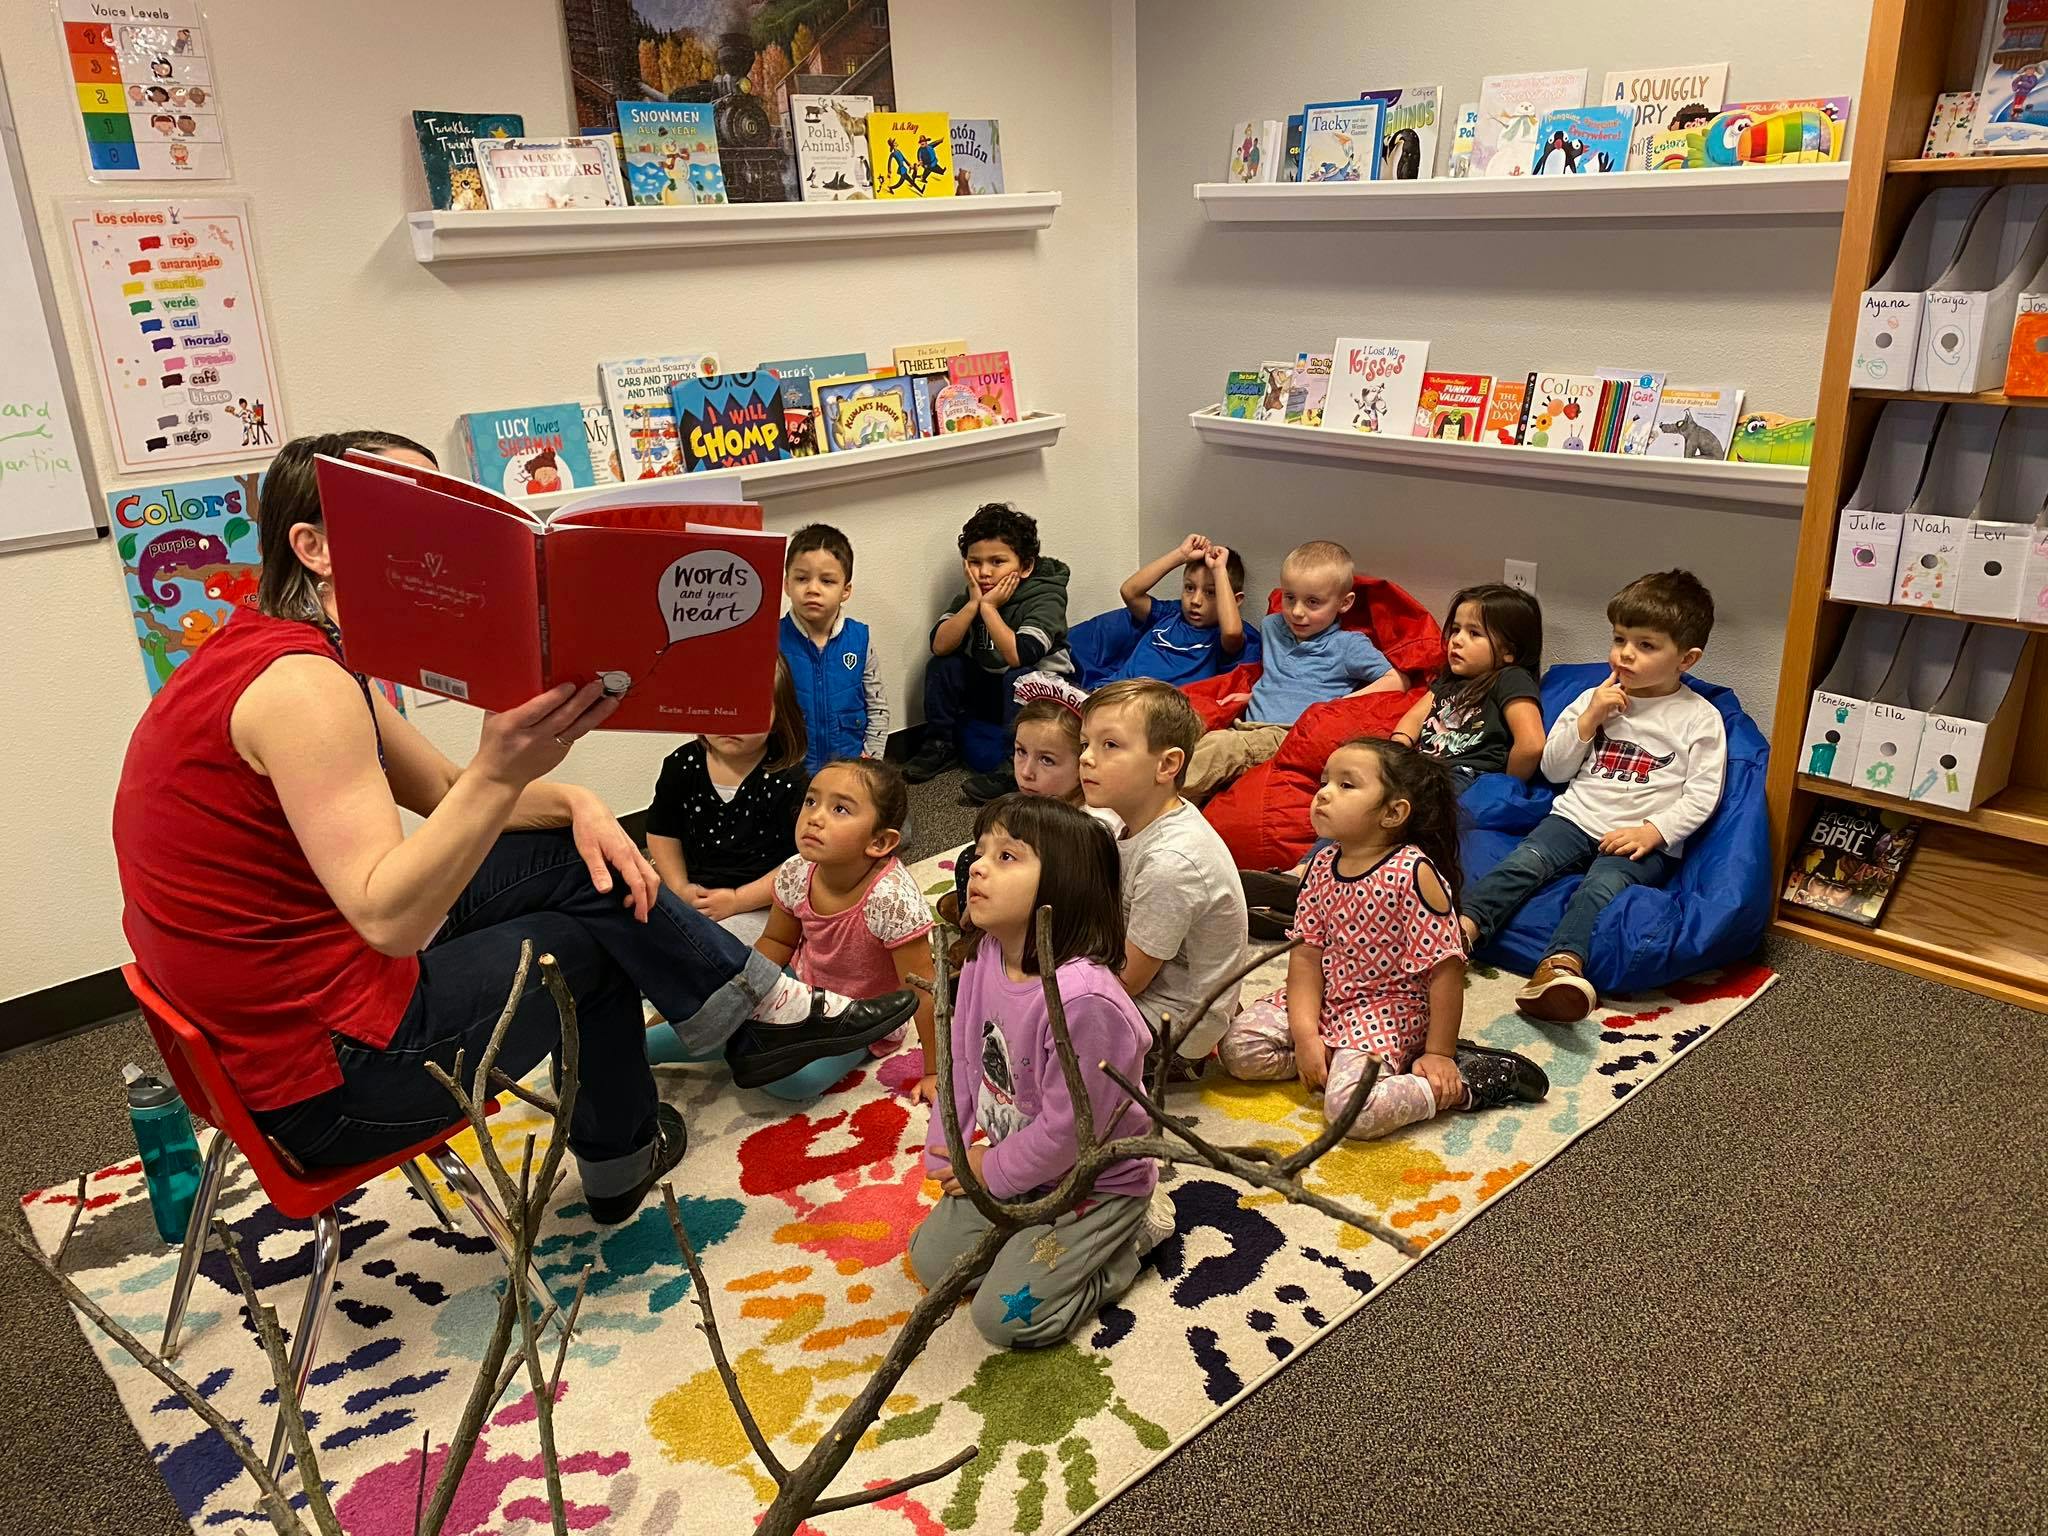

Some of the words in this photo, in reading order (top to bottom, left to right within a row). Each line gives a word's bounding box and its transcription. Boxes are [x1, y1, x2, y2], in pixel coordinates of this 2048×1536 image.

[91, 4, 126, 17] Voice
[131, 5, 169, 20] Levels
[91, 59, 102, 74] 3
[96, 90, 109, 105] 2
[1616, 81, 1625, 101] A
[1630, 76, 1709, 103] SQUIGGLY
[631, 108, 700, 124] SNOWMEN
[1312, 115, 1350, 133] Tacky
[104, 119, 114, 134] 1
[638, 127, 657, 135] ALL
[671, 127, 697, 136] YEAR
[808, 124, 838, 139] Polar
[950, 123, 976, 141] otón
[801, 137, 850, 153] Animals
[522, 153, 572, 164] ALASKA'S
[496, 164, 549, 179] THREE
[554, 162, 602, 178] BEARS
[96, 213, 117, 225] Los
[120, 211, 164, 225] colores
[171, 232, 195, 248] rojo
[159, 255, 221, 270] anaranjado
[153, 276, 205, 290] amarillo
[162, 296, 197, 309] verde
[1865, 297, 1910, 317] Ayana
[1928, 293, 1968, 313] Jiraiya
[172, 315, 198, 328] azul
[184, 332, 229, 347] morado
[194, 351, 234, 365] rosado
[1363, 346, 1368, 355] I
[1369, 346, 1386, 356] Lost
[1387, 347, 1400, 359] My
[627, 364, 661, 375] Richard
[663, 362, 696, 374] Scarry's
[900, 357, 934, 375] THREE
[1349, 348, 1406, 381] Kisses
[192, 370, 218, 384] café
[618, 377, 641, 388] CARS
[643, 375, 661, 386] AND
[979, 373, 1005, 385] LOVE
[628, 388, 646, 399] AND
[1444, 385, 1472, 394] FUNNY
[1541, 377, 1595, 398] Colors
[192, 390, 229, 403] blanco
[1439, 391, 1484, 404] VALENTINE
[1492, 400, 1523, 411] NOW
[187, 410, 210, 425] gris
[707, 406, 717, 425] I
[729, 403, 767, 425] WILL
[844, 402, 873, 429] KUMAK'S
[875, 401, 901, 423] HOUSE
[1492, 411, 1517, 421] DAY
[495, 417, 529, 439] LUCY
[533, 417, 560, 434] loves
[583, 419, 609, 446] My
[176, 430, 209, 444] negro
[689, 422, 779, 464] CHOMP
[115, 489, 242, 529] Colors
[1850, 514, 1887, 532] Julie
[1913, 518, 1951, 534] Noah
[1974, 523, 2006, 541] Levi
[149, 535, 196, 557] purple
[243, 593, 257, 604] re
[680, 588, 703, 599] and
[707, 590, 739, 606] your
[673, 601, 745, 622] heart
[1015, 681, 1063, 702] BIRTHDAY
[1817, 692, 1857, 710] Penelope
[658, 704, 683, 715] Kate
[686, 705, 711, 716] Jane
[714, 706, 738, 717] Neal
[1874, 705, 1906, 721] Ella
[1935, 718, 1968, 736] Quin
[1826, 812, 1879, 835] ACTION
[1811, 822, 1872, 856] BIBLE
